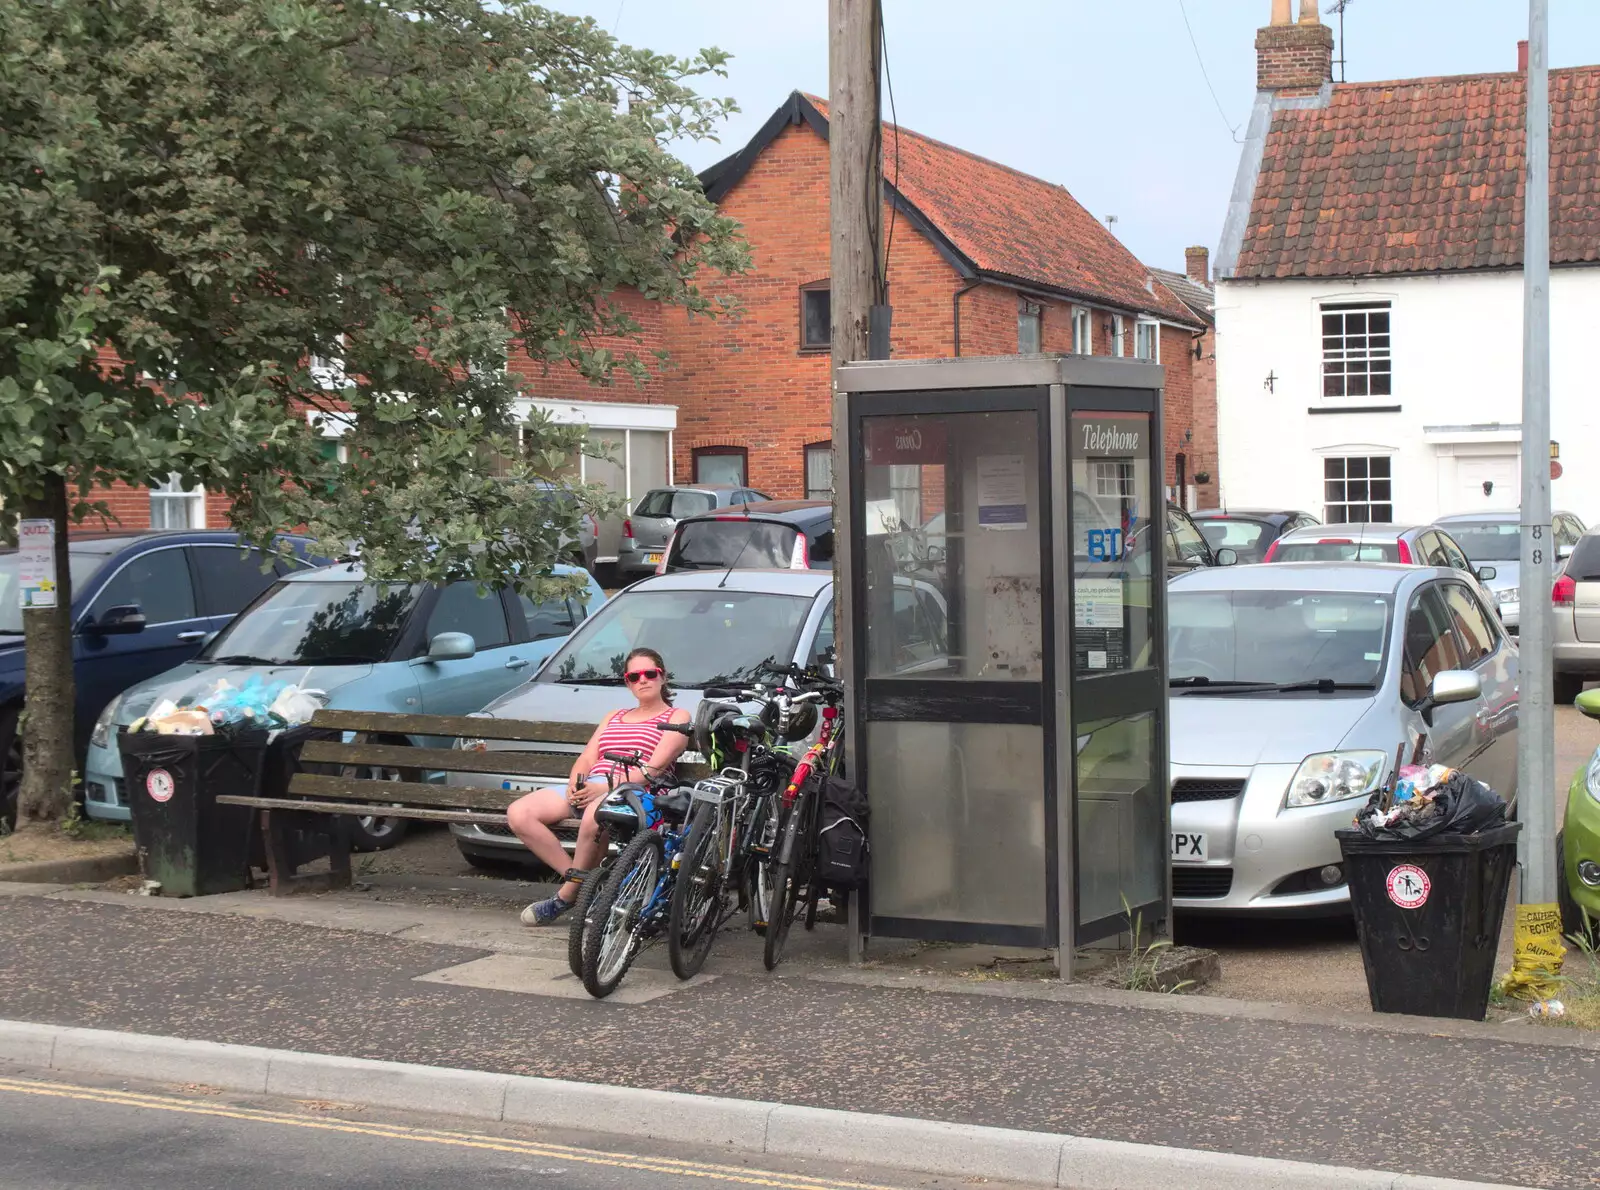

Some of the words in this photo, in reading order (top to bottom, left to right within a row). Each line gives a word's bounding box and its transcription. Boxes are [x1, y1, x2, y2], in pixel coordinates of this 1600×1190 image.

[1082, 424, 1139, 455] Telephone
[24, 525, 49, 536] QUIZ
[1088, 528, 1122, 563] BT
